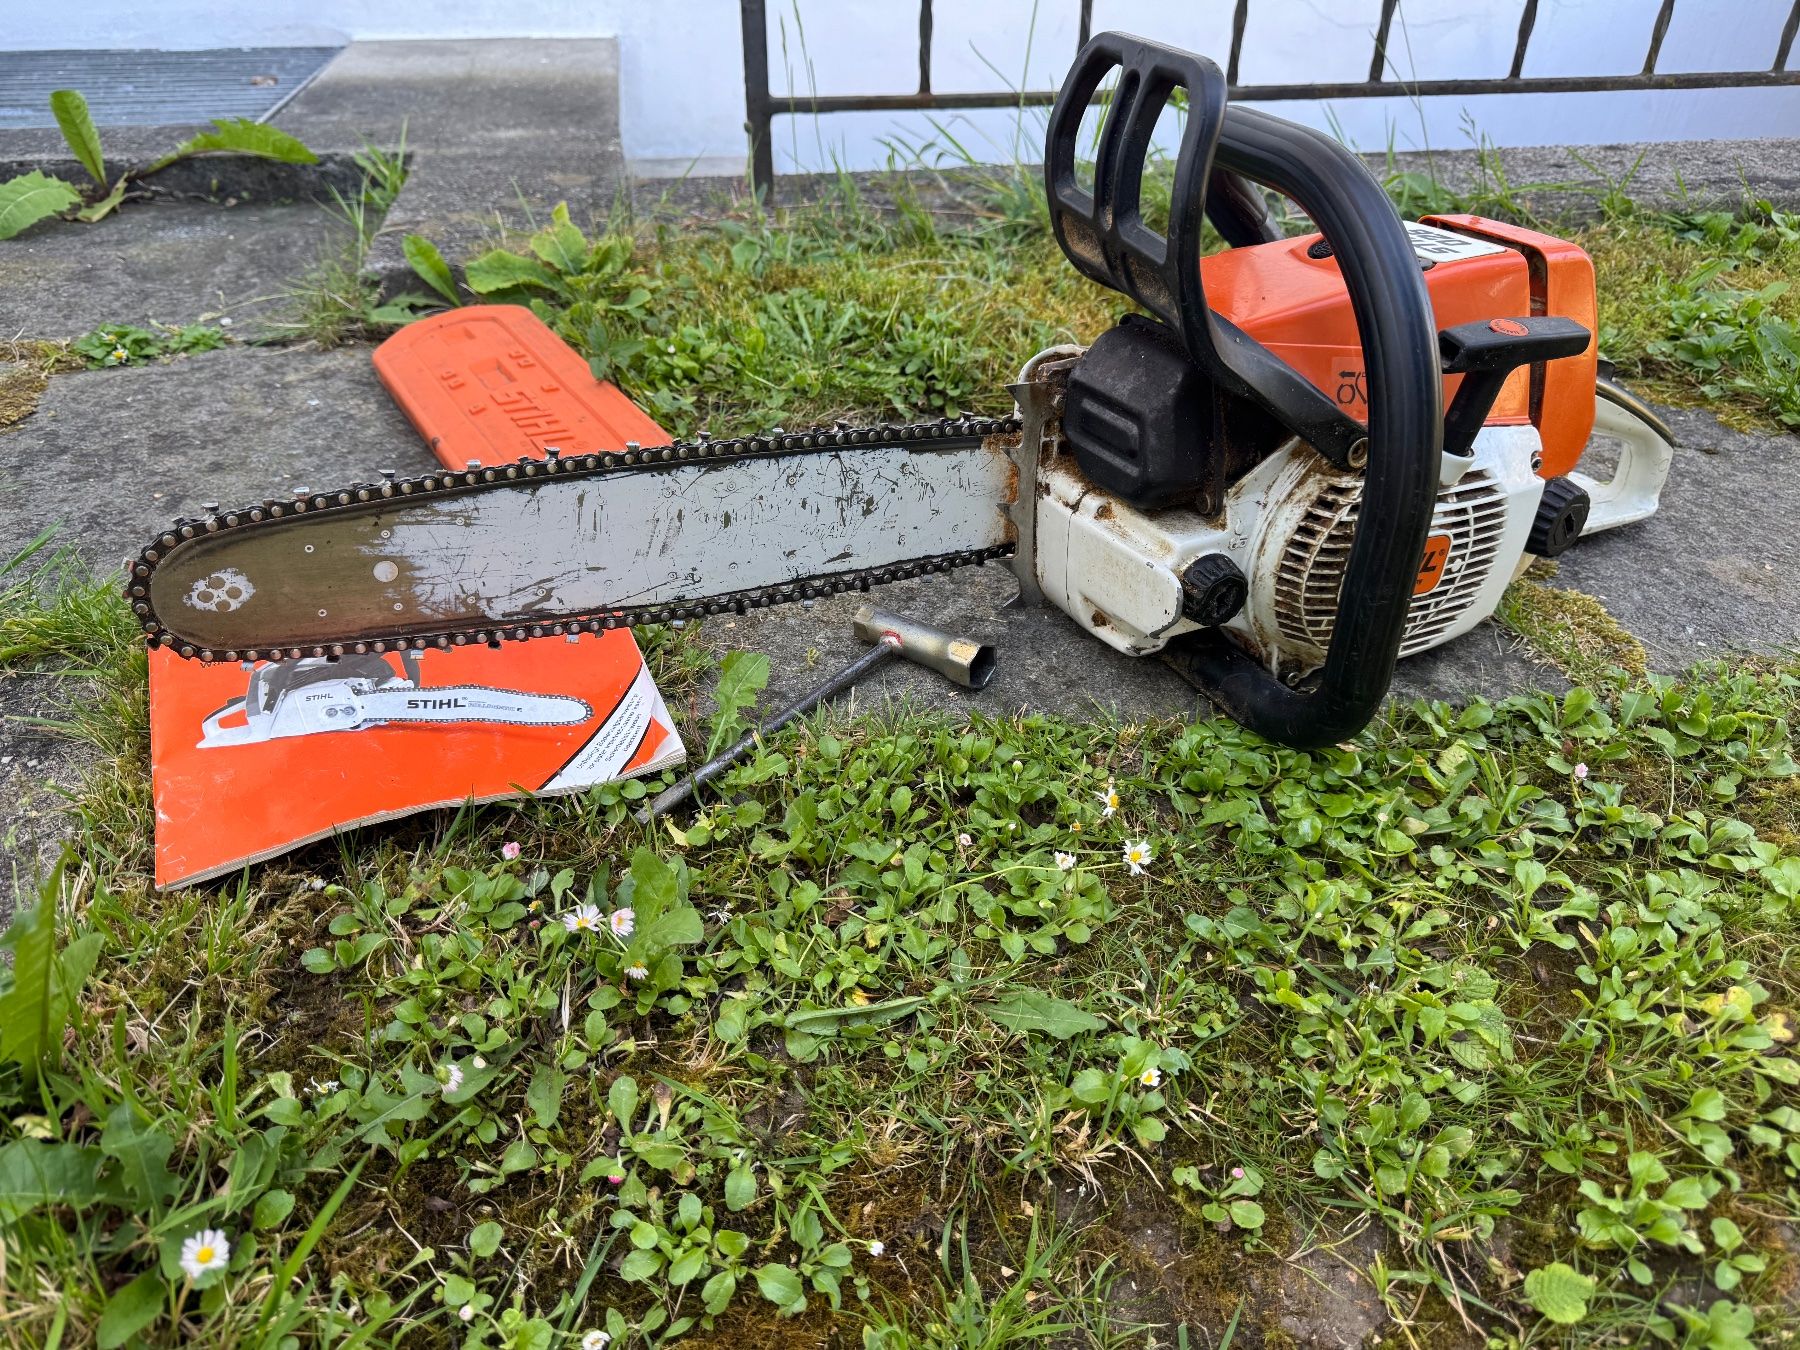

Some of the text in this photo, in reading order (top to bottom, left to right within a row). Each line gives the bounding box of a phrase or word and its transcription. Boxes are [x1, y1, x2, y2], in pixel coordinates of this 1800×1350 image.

[1410, 237, 1462, 254] STI
[488, 391, 576, 456] STIHL
[305, 692, 334, 702] STIHL
[406, 697, 467, 710] STIHL
